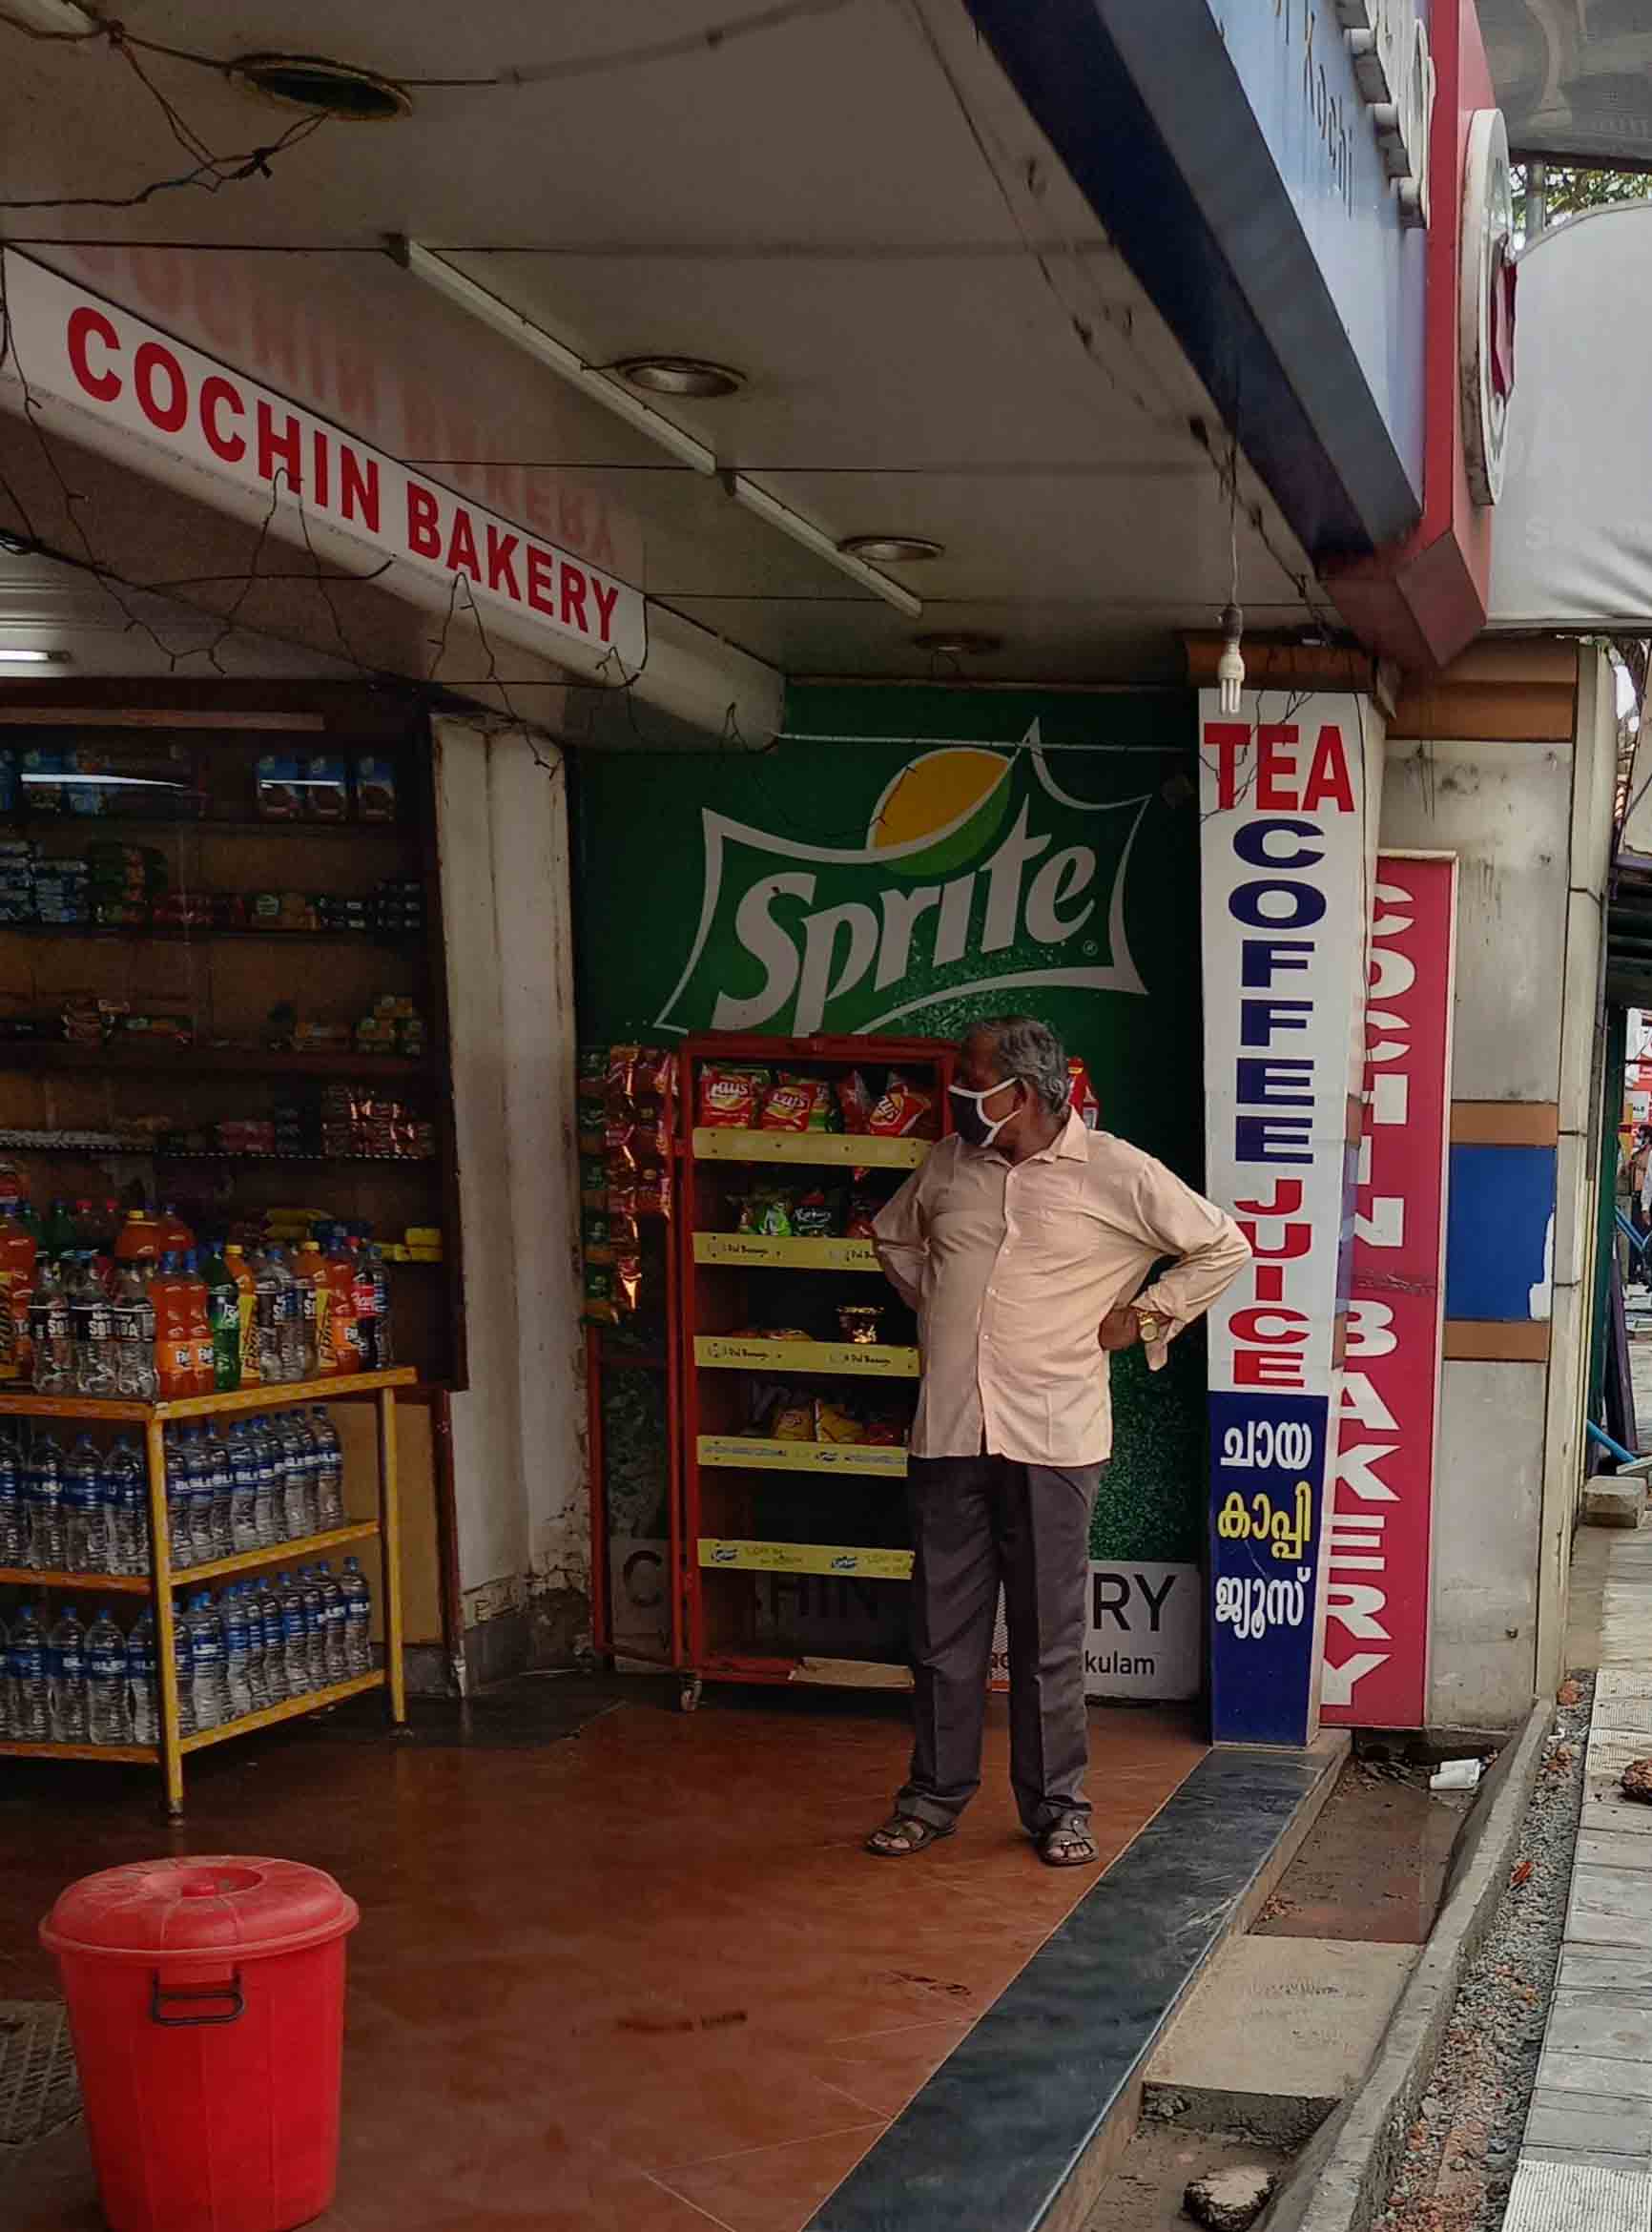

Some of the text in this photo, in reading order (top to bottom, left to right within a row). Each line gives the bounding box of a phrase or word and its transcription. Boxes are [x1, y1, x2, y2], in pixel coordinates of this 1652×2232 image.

[67, 306, 620, 643] COCHIN BAKERY
[1204, 722, 1355, 813] TEA
[712, 793, 1097, 1038] Sprite
[1228, 817, 1328, 1164] COFFEE
[1228, 1178, 1312, 1389] JUICE
[1217, 1480, 1312, 1560] കാപ്പി
[1220, 1420, 1313, 1471] ചായ
[1319, 1298, 1402, 1707] BAKERY
[1214, 1566, 1311, 1640] ജ്യൂസ്
